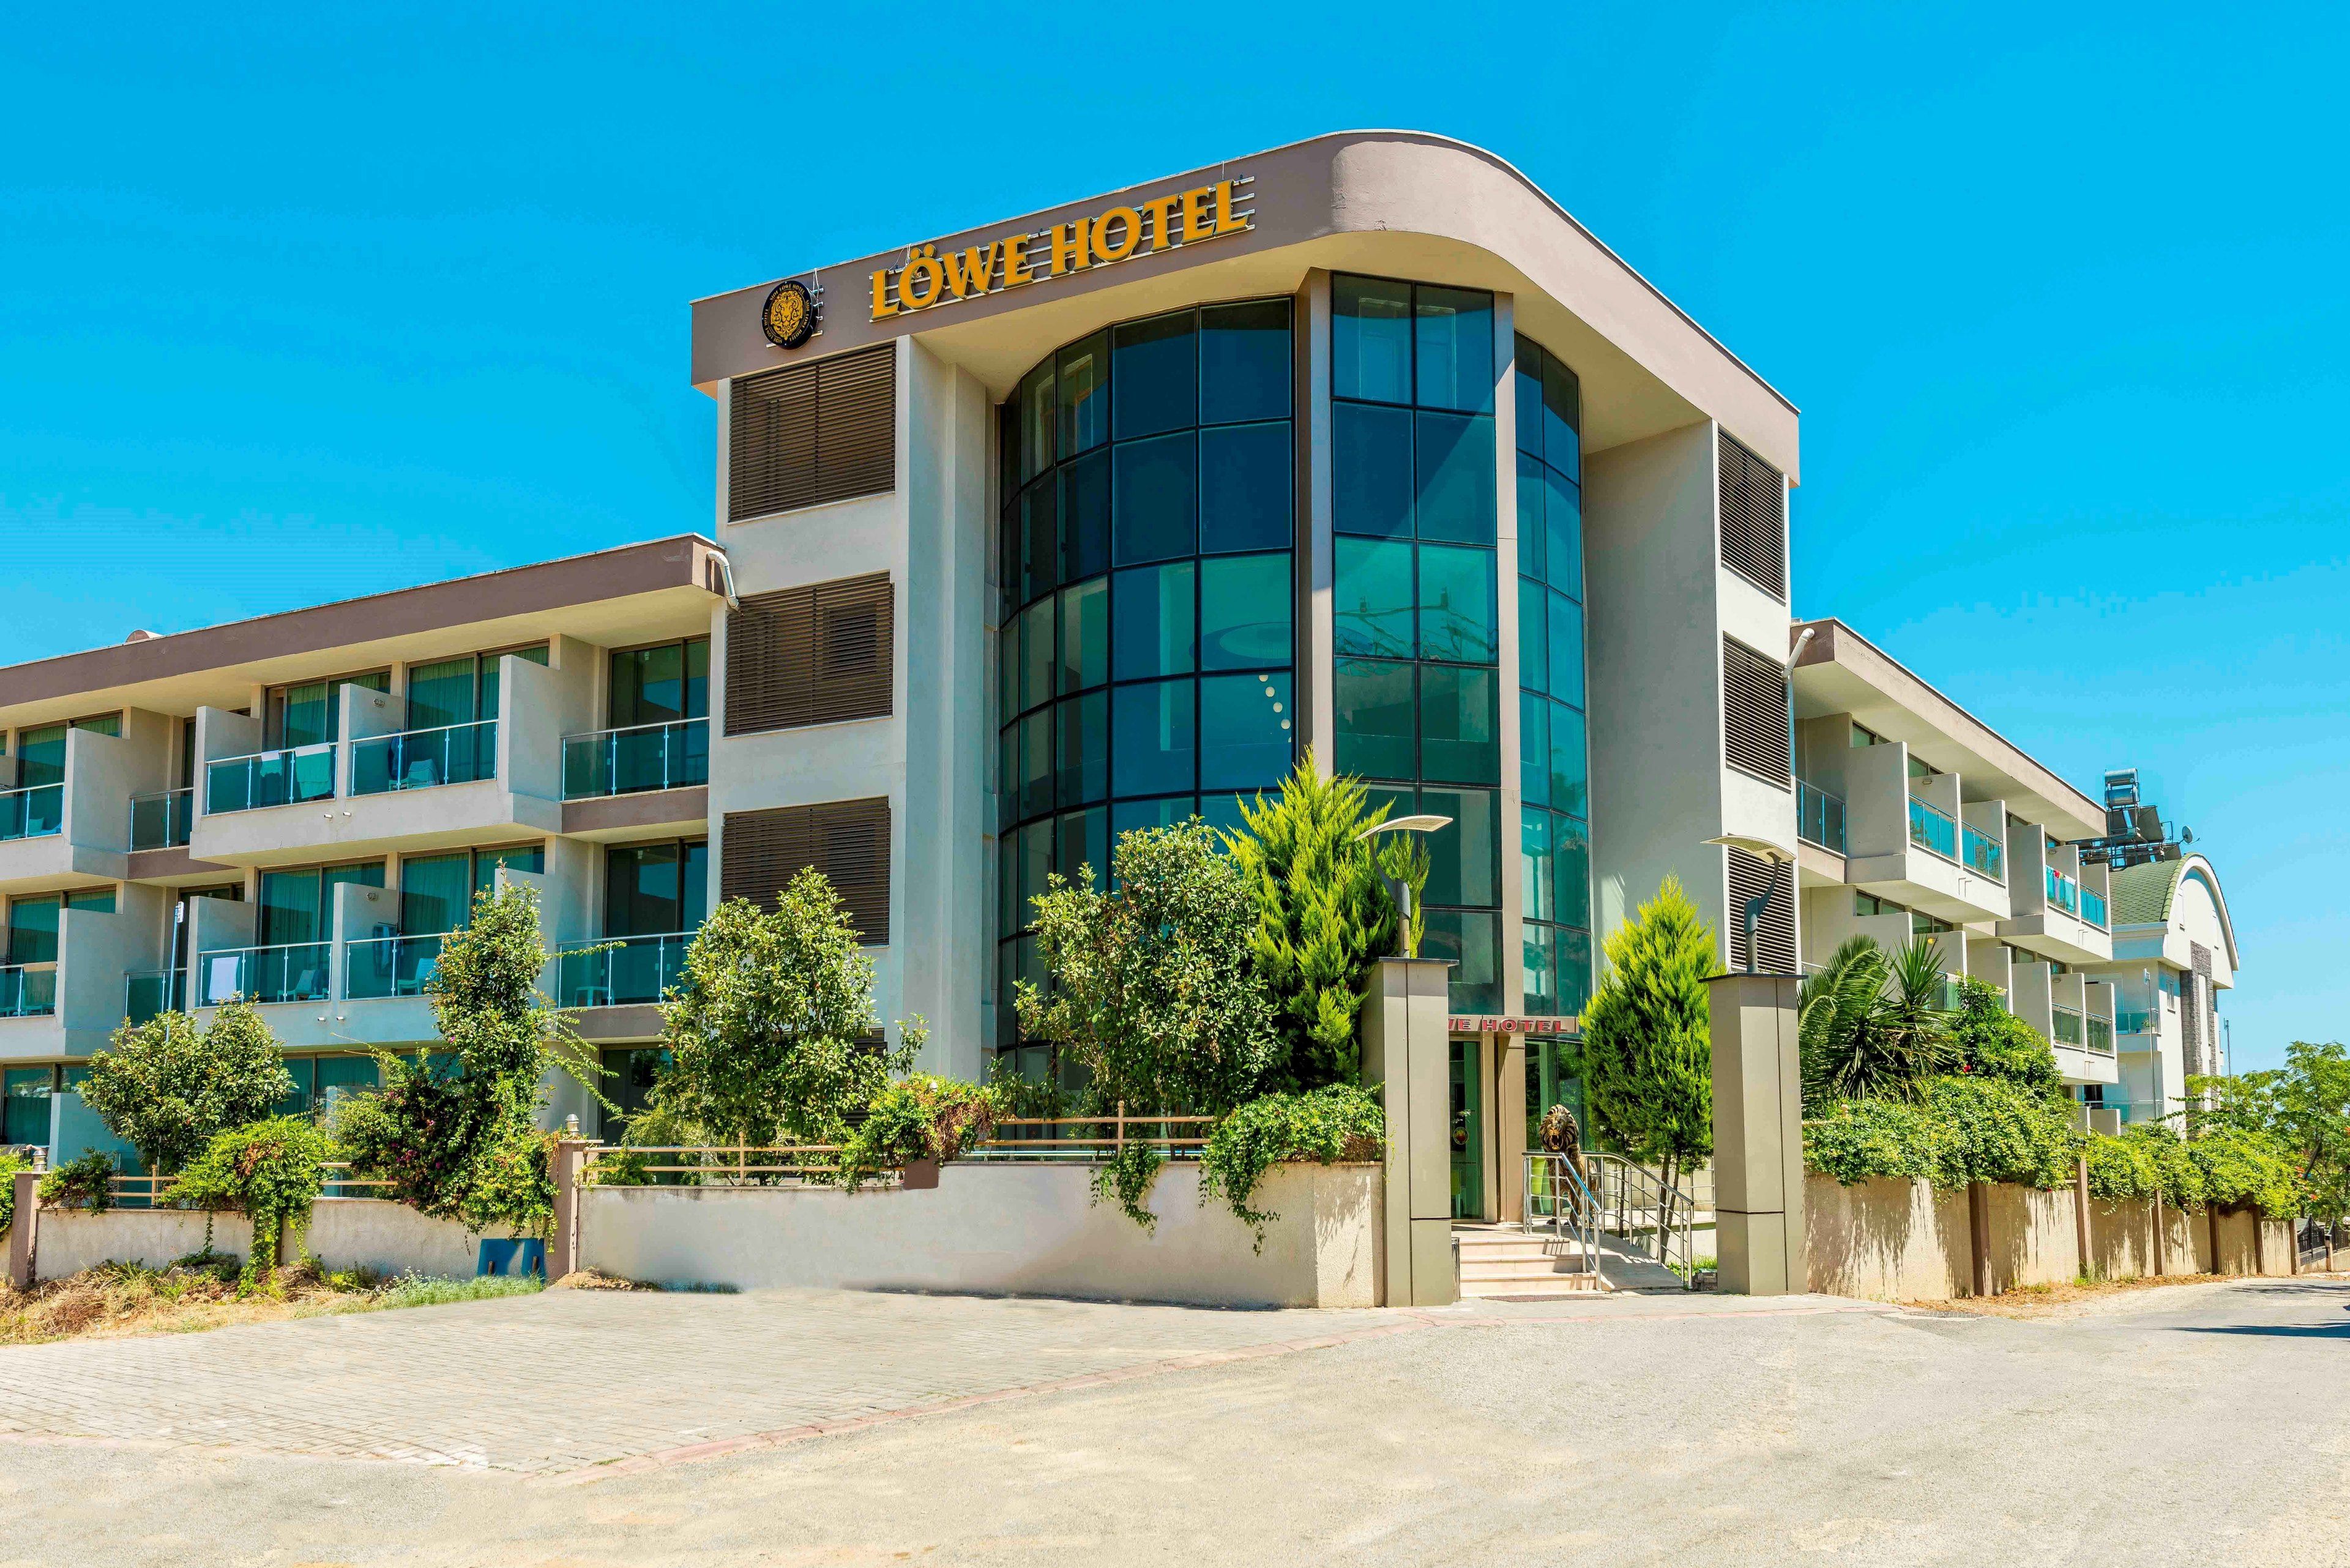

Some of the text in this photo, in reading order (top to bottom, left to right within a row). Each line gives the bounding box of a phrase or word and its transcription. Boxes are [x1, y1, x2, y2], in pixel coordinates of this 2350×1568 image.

[870, 179, 1250, 319] LÖWE HOTEL
[1482, 1018, 1567, 1032] HOTEL
